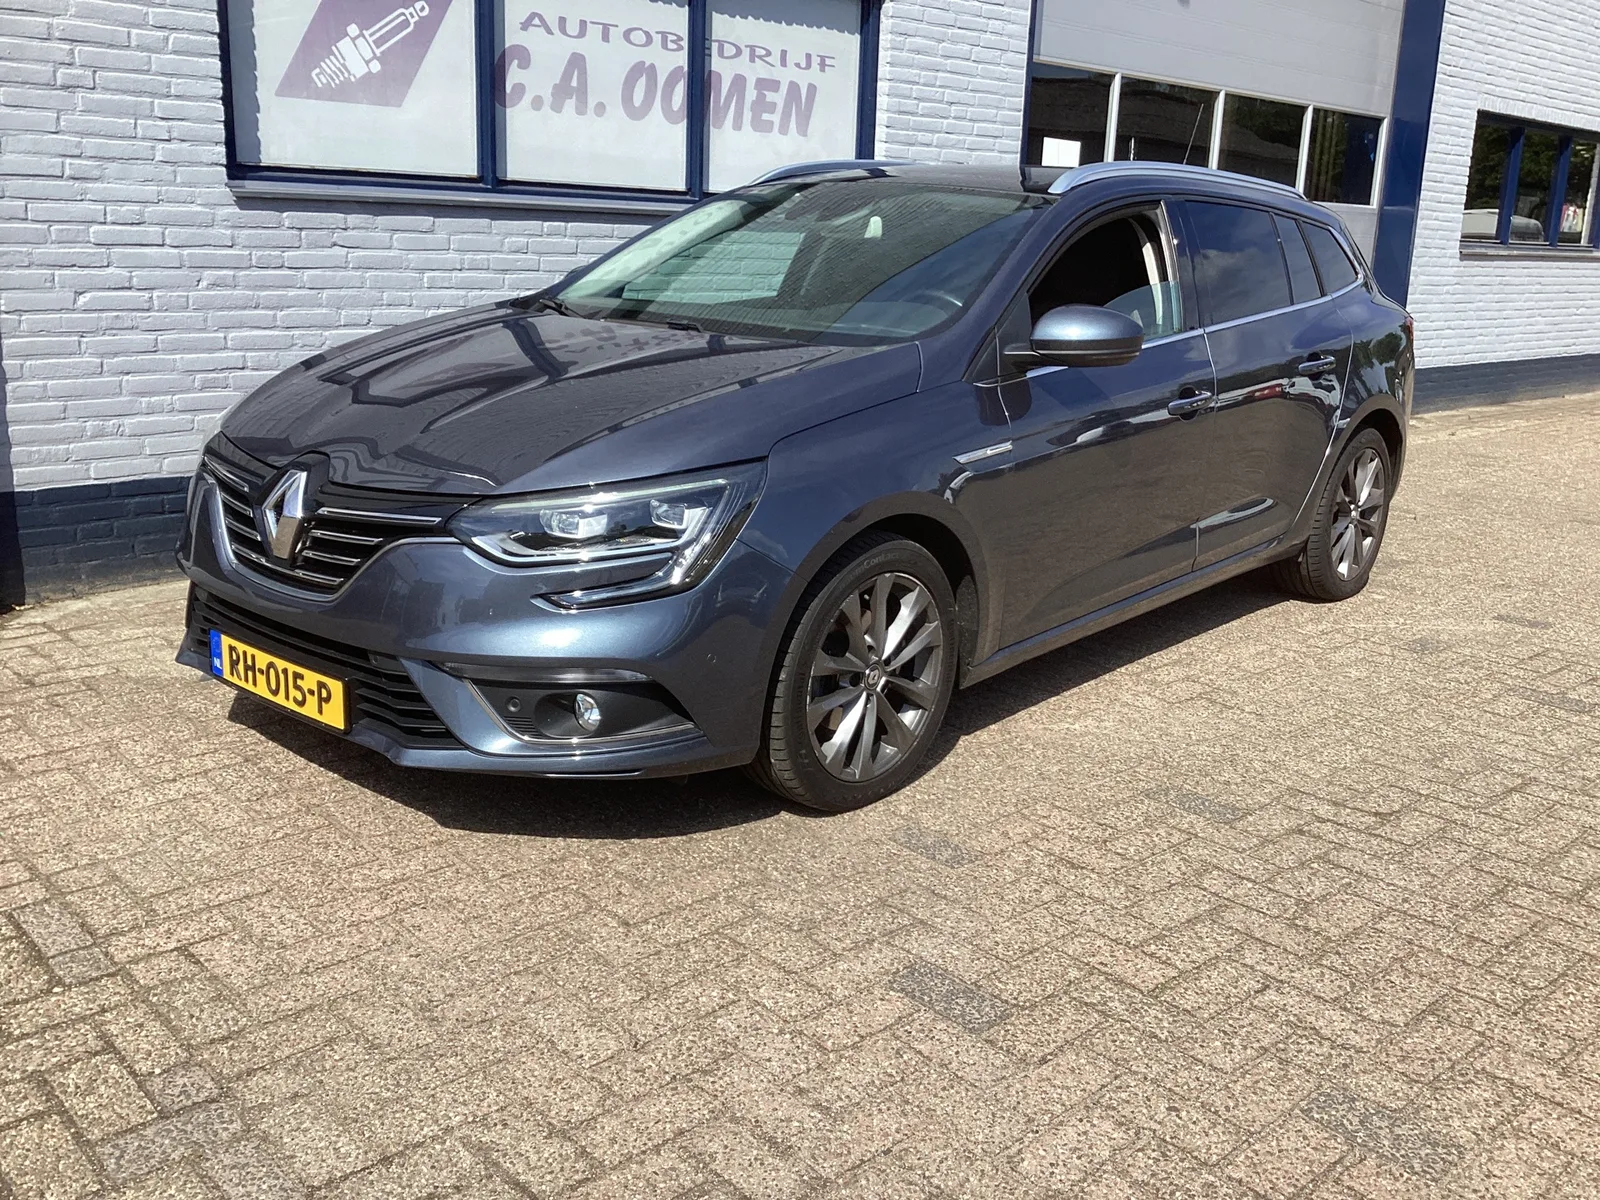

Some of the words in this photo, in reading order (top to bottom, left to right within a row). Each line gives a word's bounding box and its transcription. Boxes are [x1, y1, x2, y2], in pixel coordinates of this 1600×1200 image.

[494, 44, 606, 118] C.A.
[621, 60, 817, 138] OOMEN
[213, 657, 223, 670] NL
[228, 643, 332, 716] RH-015-P
